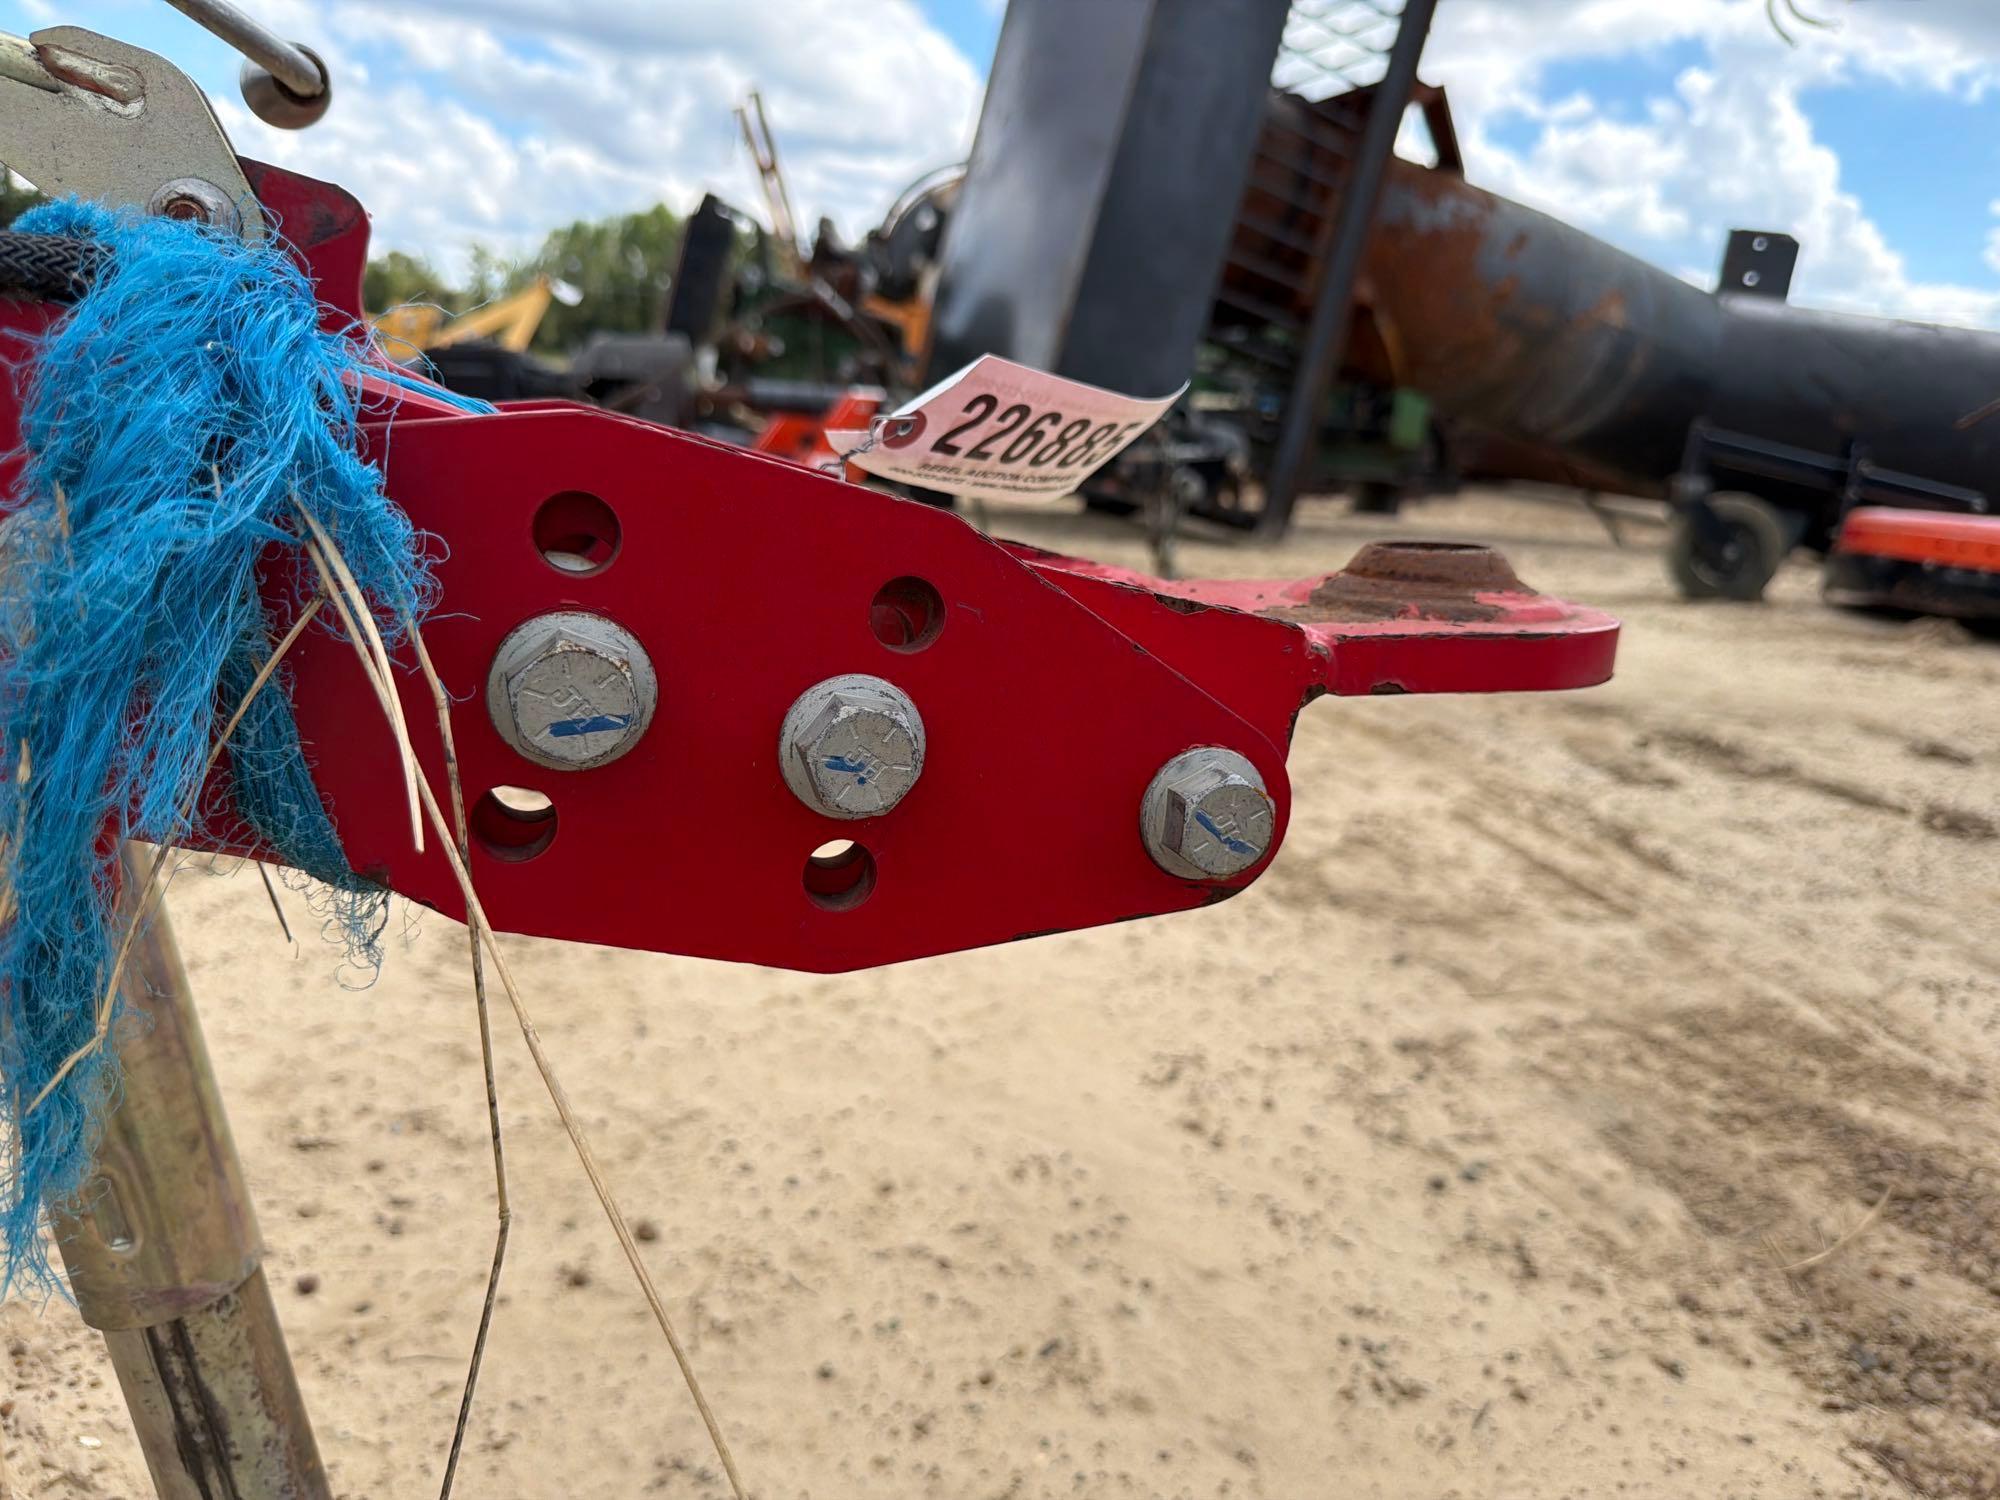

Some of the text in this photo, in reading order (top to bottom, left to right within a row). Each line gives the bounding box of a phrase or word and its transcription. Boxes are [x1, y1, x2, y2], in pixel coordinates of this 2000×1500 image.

[931, 394, 1145, 468] 226885
[919, 463, 961, 476] REBEL
[966, 469, 1021, 481] AUCTION
